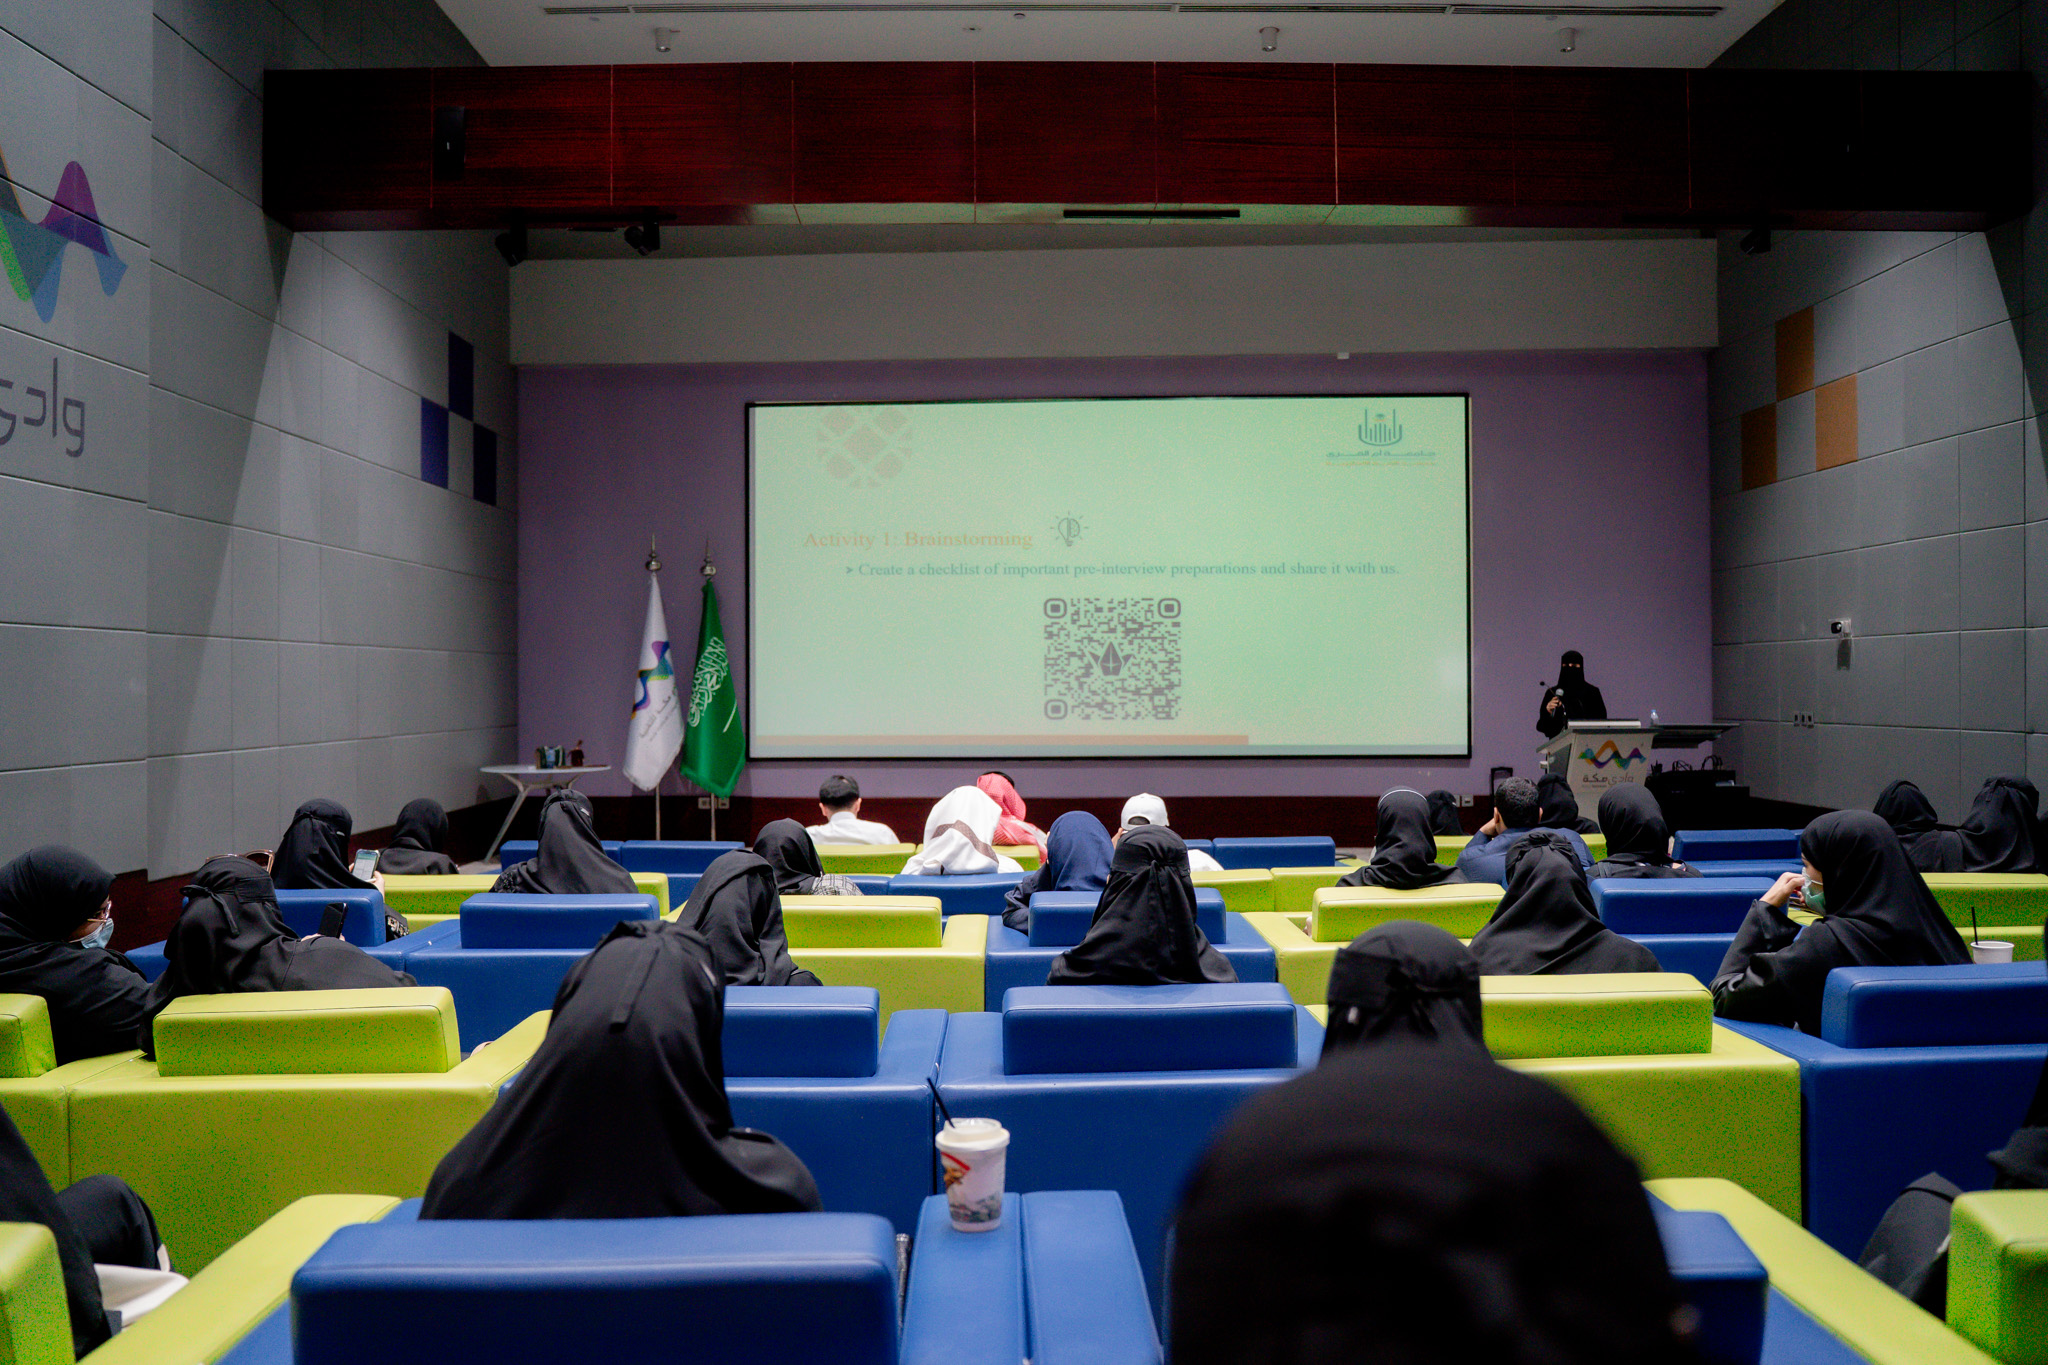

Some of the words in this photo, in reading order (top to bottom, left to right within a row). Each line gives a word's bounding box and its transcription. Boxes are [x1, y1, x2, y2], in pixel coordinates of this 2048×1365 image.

[803, 532, 876, 551] Activity
[884, 531, 898, 547] 1:
[905, 530, 1034, 550] Brainstorming
[858, 563, 903, 576] Create
[907, 567, 915, 576] a
[919, 562, 980, 576] checklist
[984, 562, 1000, 576] of
[1003, 562, 1070, 578] important
[1073, 562, 1168, 578] pre-interview
[1171, 561, 1257, 578] preparations
[1260, 561, 1286, 575] and
[1290, 561, 1328, 575] share
[1331, 562, 1341, 575] it
[1345, 561, 1377, 575] with
[1380, 565, 1401, 575] us.
